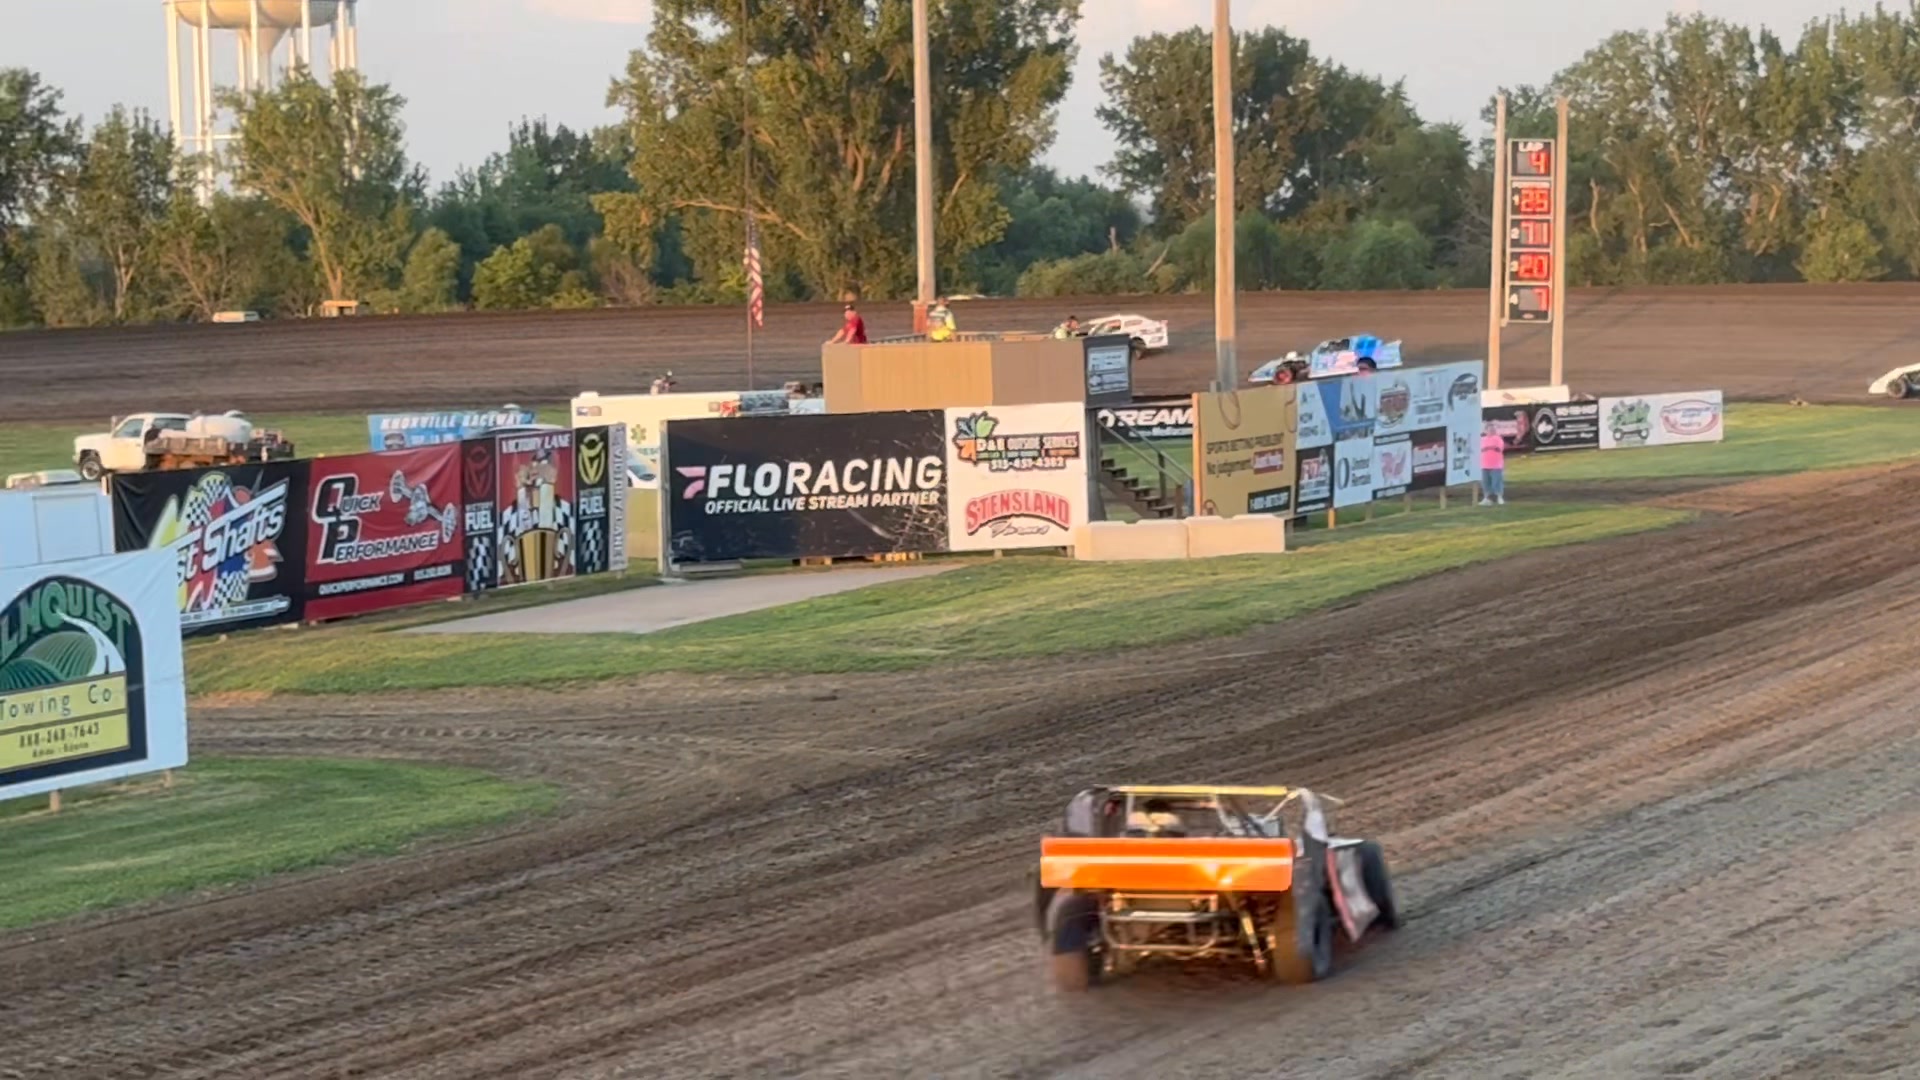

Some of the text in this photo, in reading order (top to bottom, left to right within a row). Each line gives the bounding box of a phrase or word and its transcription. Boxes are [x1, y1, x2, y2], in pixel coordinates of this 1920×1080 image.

[1518, 142, 1544, 152] LAP
[1531, 152, 1547, 174] 4
[1510, 227, 1519, 239] 2
[380, 412, 524, 430] KNOXVILLE RACEWAY
[544, 433, 571, 448] LANE
[707, 456, 943, 498] FLORACING
[312, 473, 384, 523] QUICK
[579, 495, 606, 515] FUEL
[705, 491, 940, 514] OFFICIAL LIVE STREAM PARTNER
[465, 511, 494, 532] FUEL
[966, 489, 1070, 535] STENSLAND
[202, 487, 287, 572] Shafts
[317, 516, 440, 564] PERFORMANCE
[88, 684, 112, 704] Co
